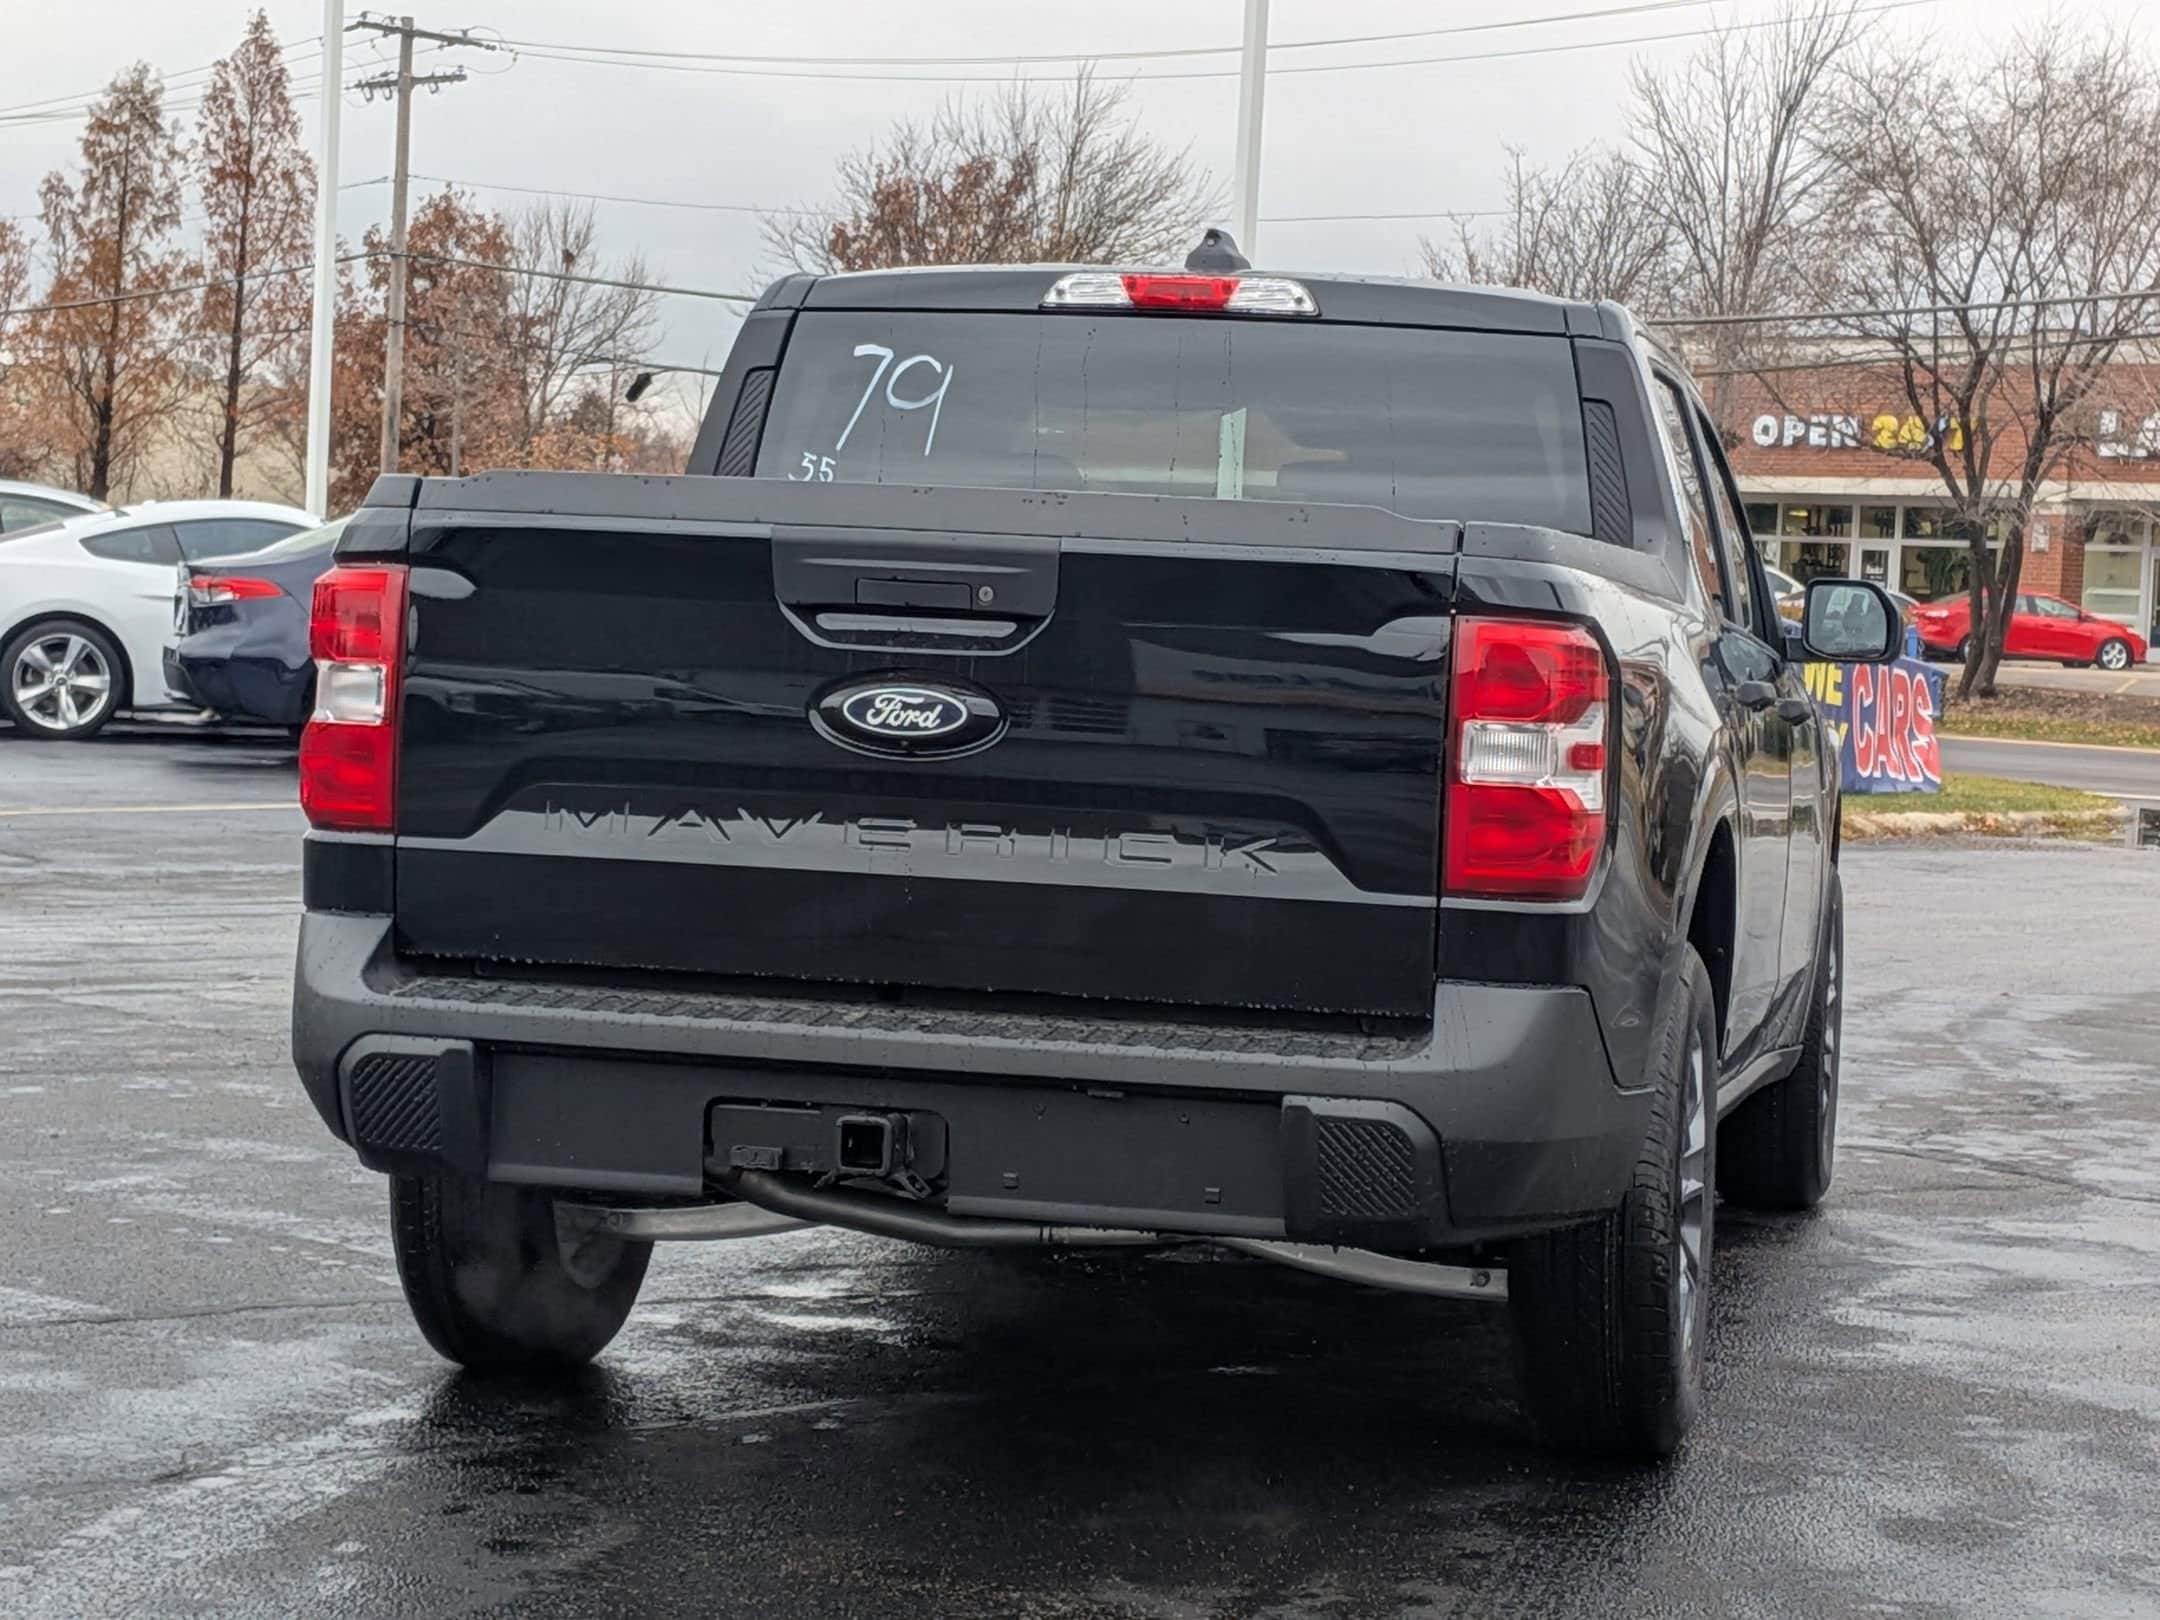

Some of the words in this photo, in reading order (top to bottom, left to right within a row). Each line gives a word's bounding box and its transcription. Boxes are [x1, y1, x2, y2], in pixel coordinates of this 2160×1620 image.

[836, 343, 954, 456] 79
[1752, 414, 1862, 448] OPEN
[865, 693, 943, 729] Ford
[1803, 662, 1843, 706] WE
[1852, 663, 1942, 784] CARS
[543, 800, 1279, 877] MAVERICK
